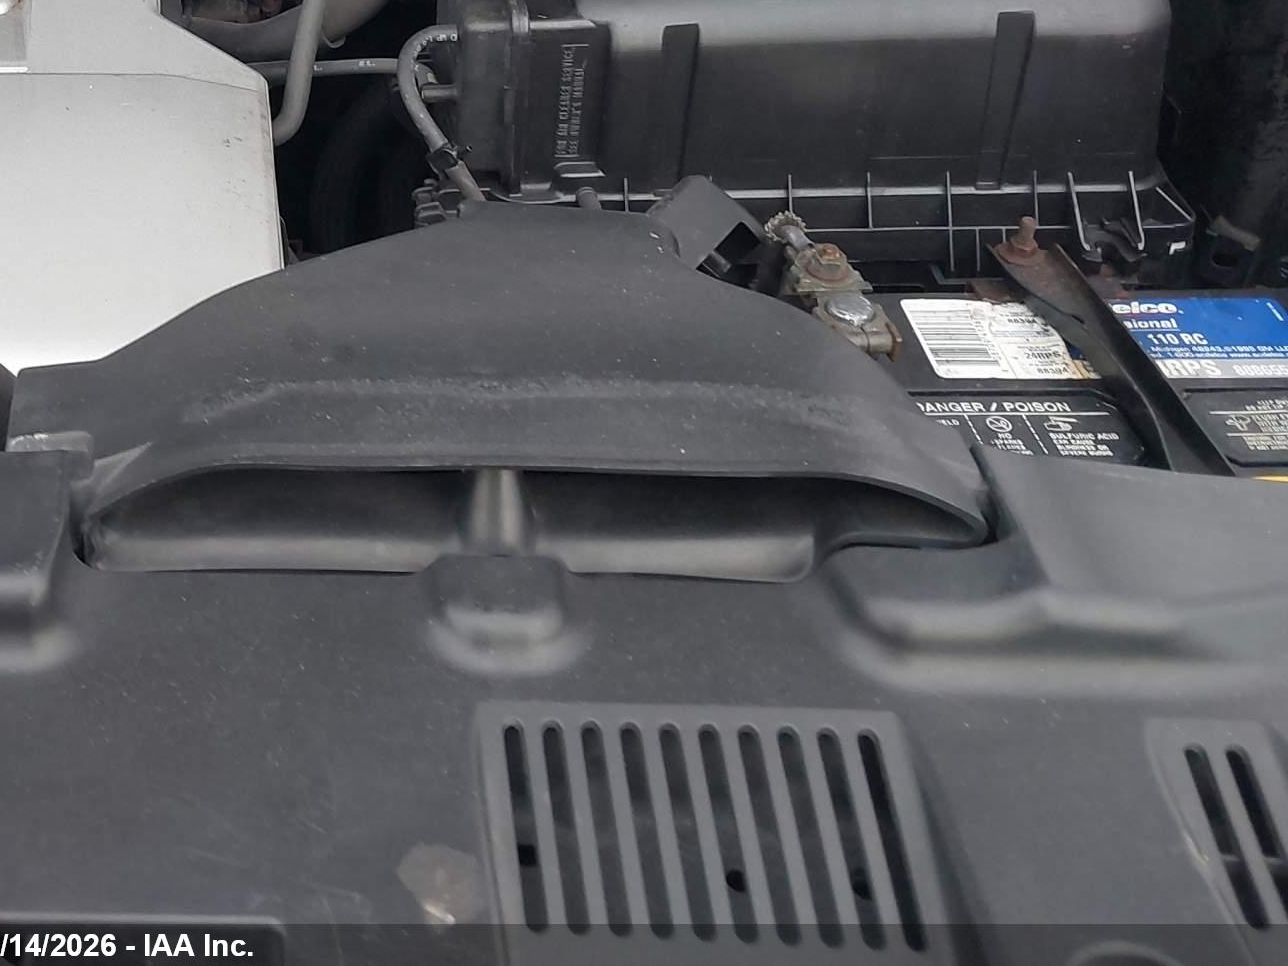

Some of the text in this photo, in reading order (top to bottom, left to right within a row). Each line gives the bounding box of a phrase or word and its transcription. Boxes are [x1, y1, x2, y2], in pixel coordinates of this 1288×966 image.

[1109, 301, 1178, 315] elco
[1147, 333, 1208, 345] 110 RC
[990, 402, 998, 412] /
[1002, 402, 1071, 412] POISON
